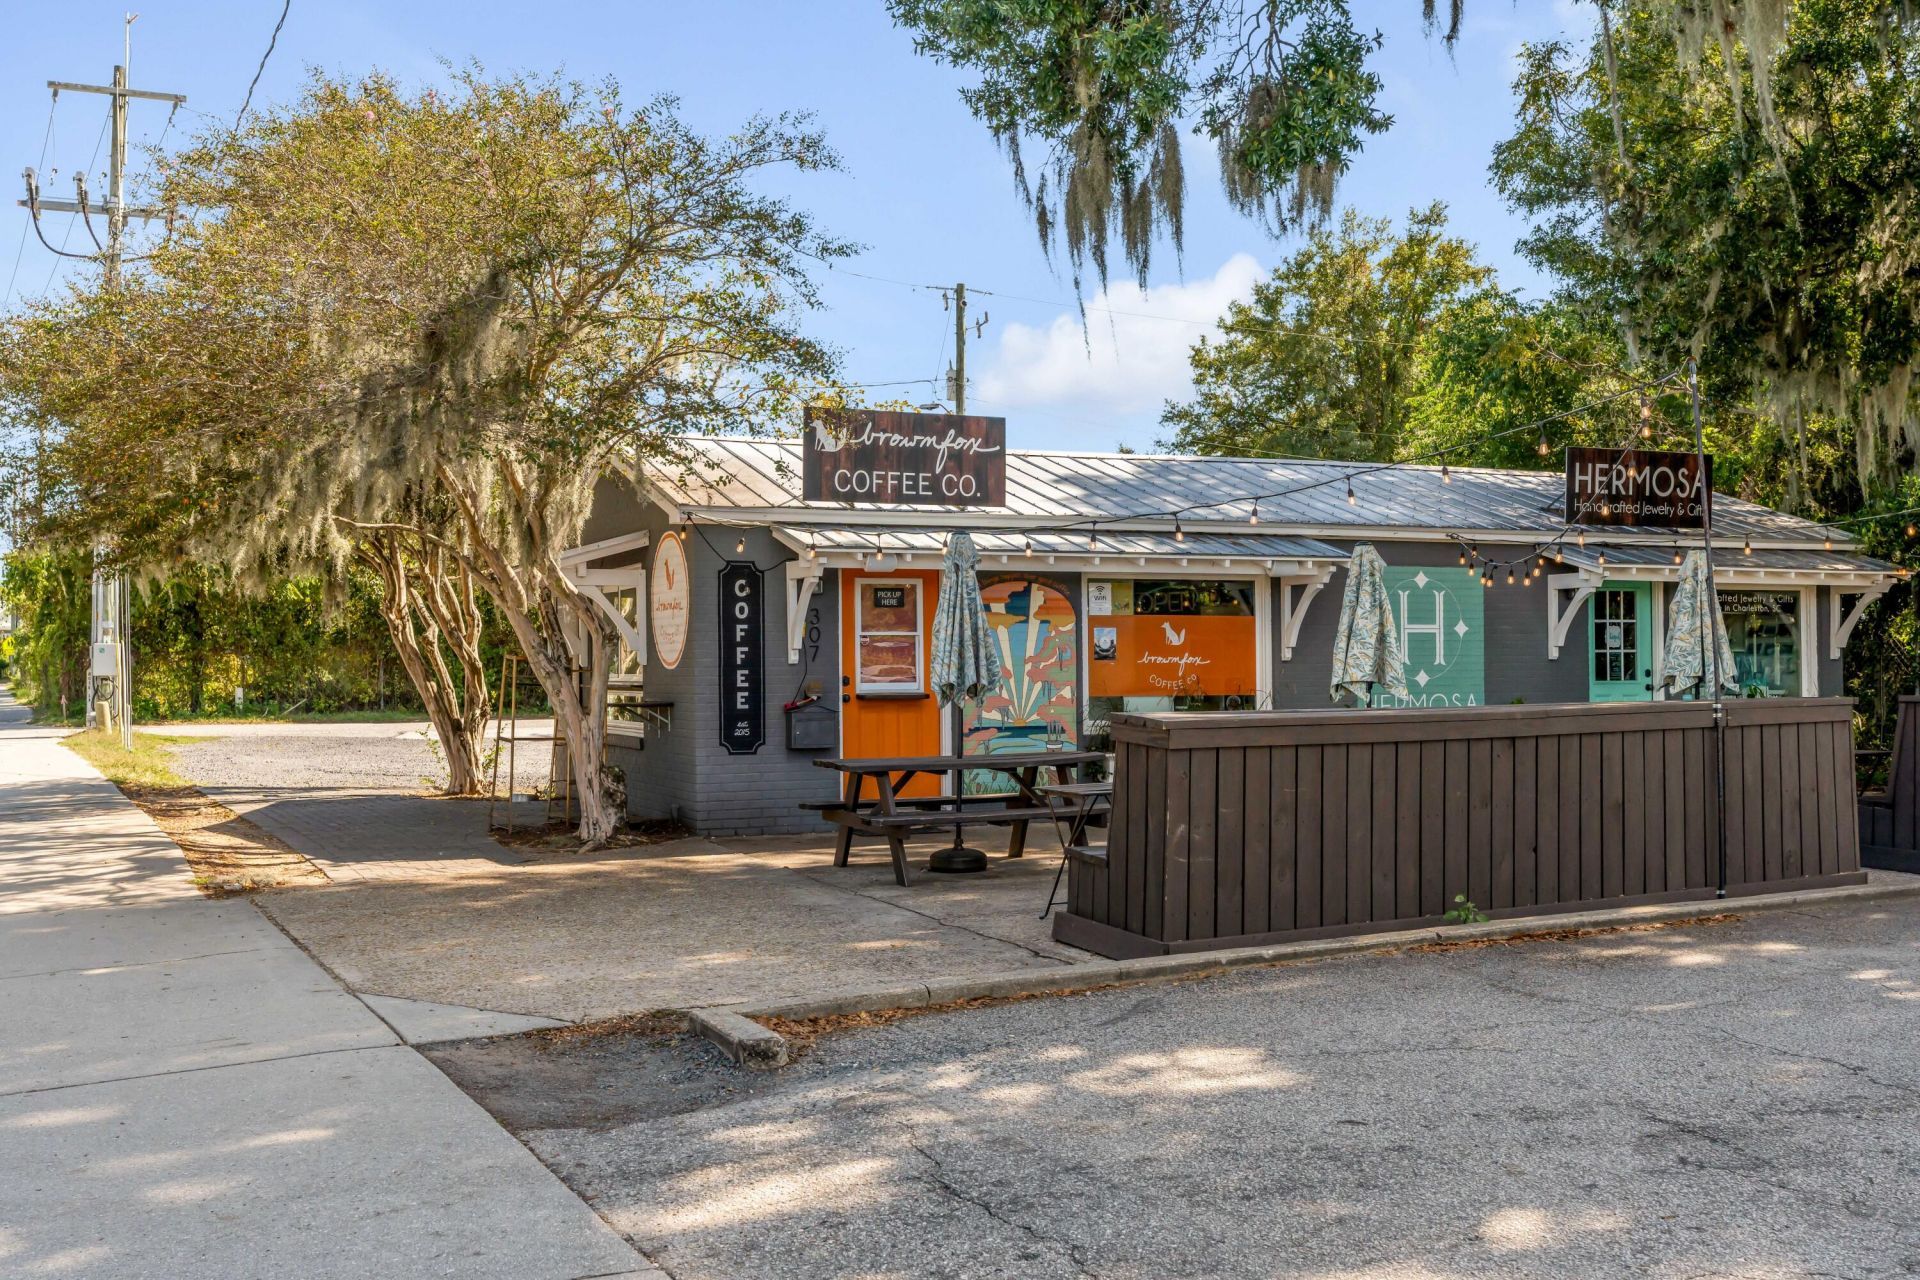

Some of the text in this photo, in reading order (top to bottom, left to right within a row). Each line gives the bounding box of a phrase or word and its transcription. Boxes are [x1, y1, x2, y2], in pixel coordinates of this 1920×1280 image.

[850, 422, 1001, 475] brownfox
[834, 469, 981, 497] COFFEE CO.
[1574, 498, 1704, 518] Handrafted Jewelry & Gift
[1740, 594, 1766, 604] Jewelry
[809, 608, 821, 662] 307
[1398, 590, 1446, 666] H
[734, 579, 750, 710] COFFEE
[1137, 651, 1211, 677] brownfox
[1149, 674, 1184, 690] COFFEE
